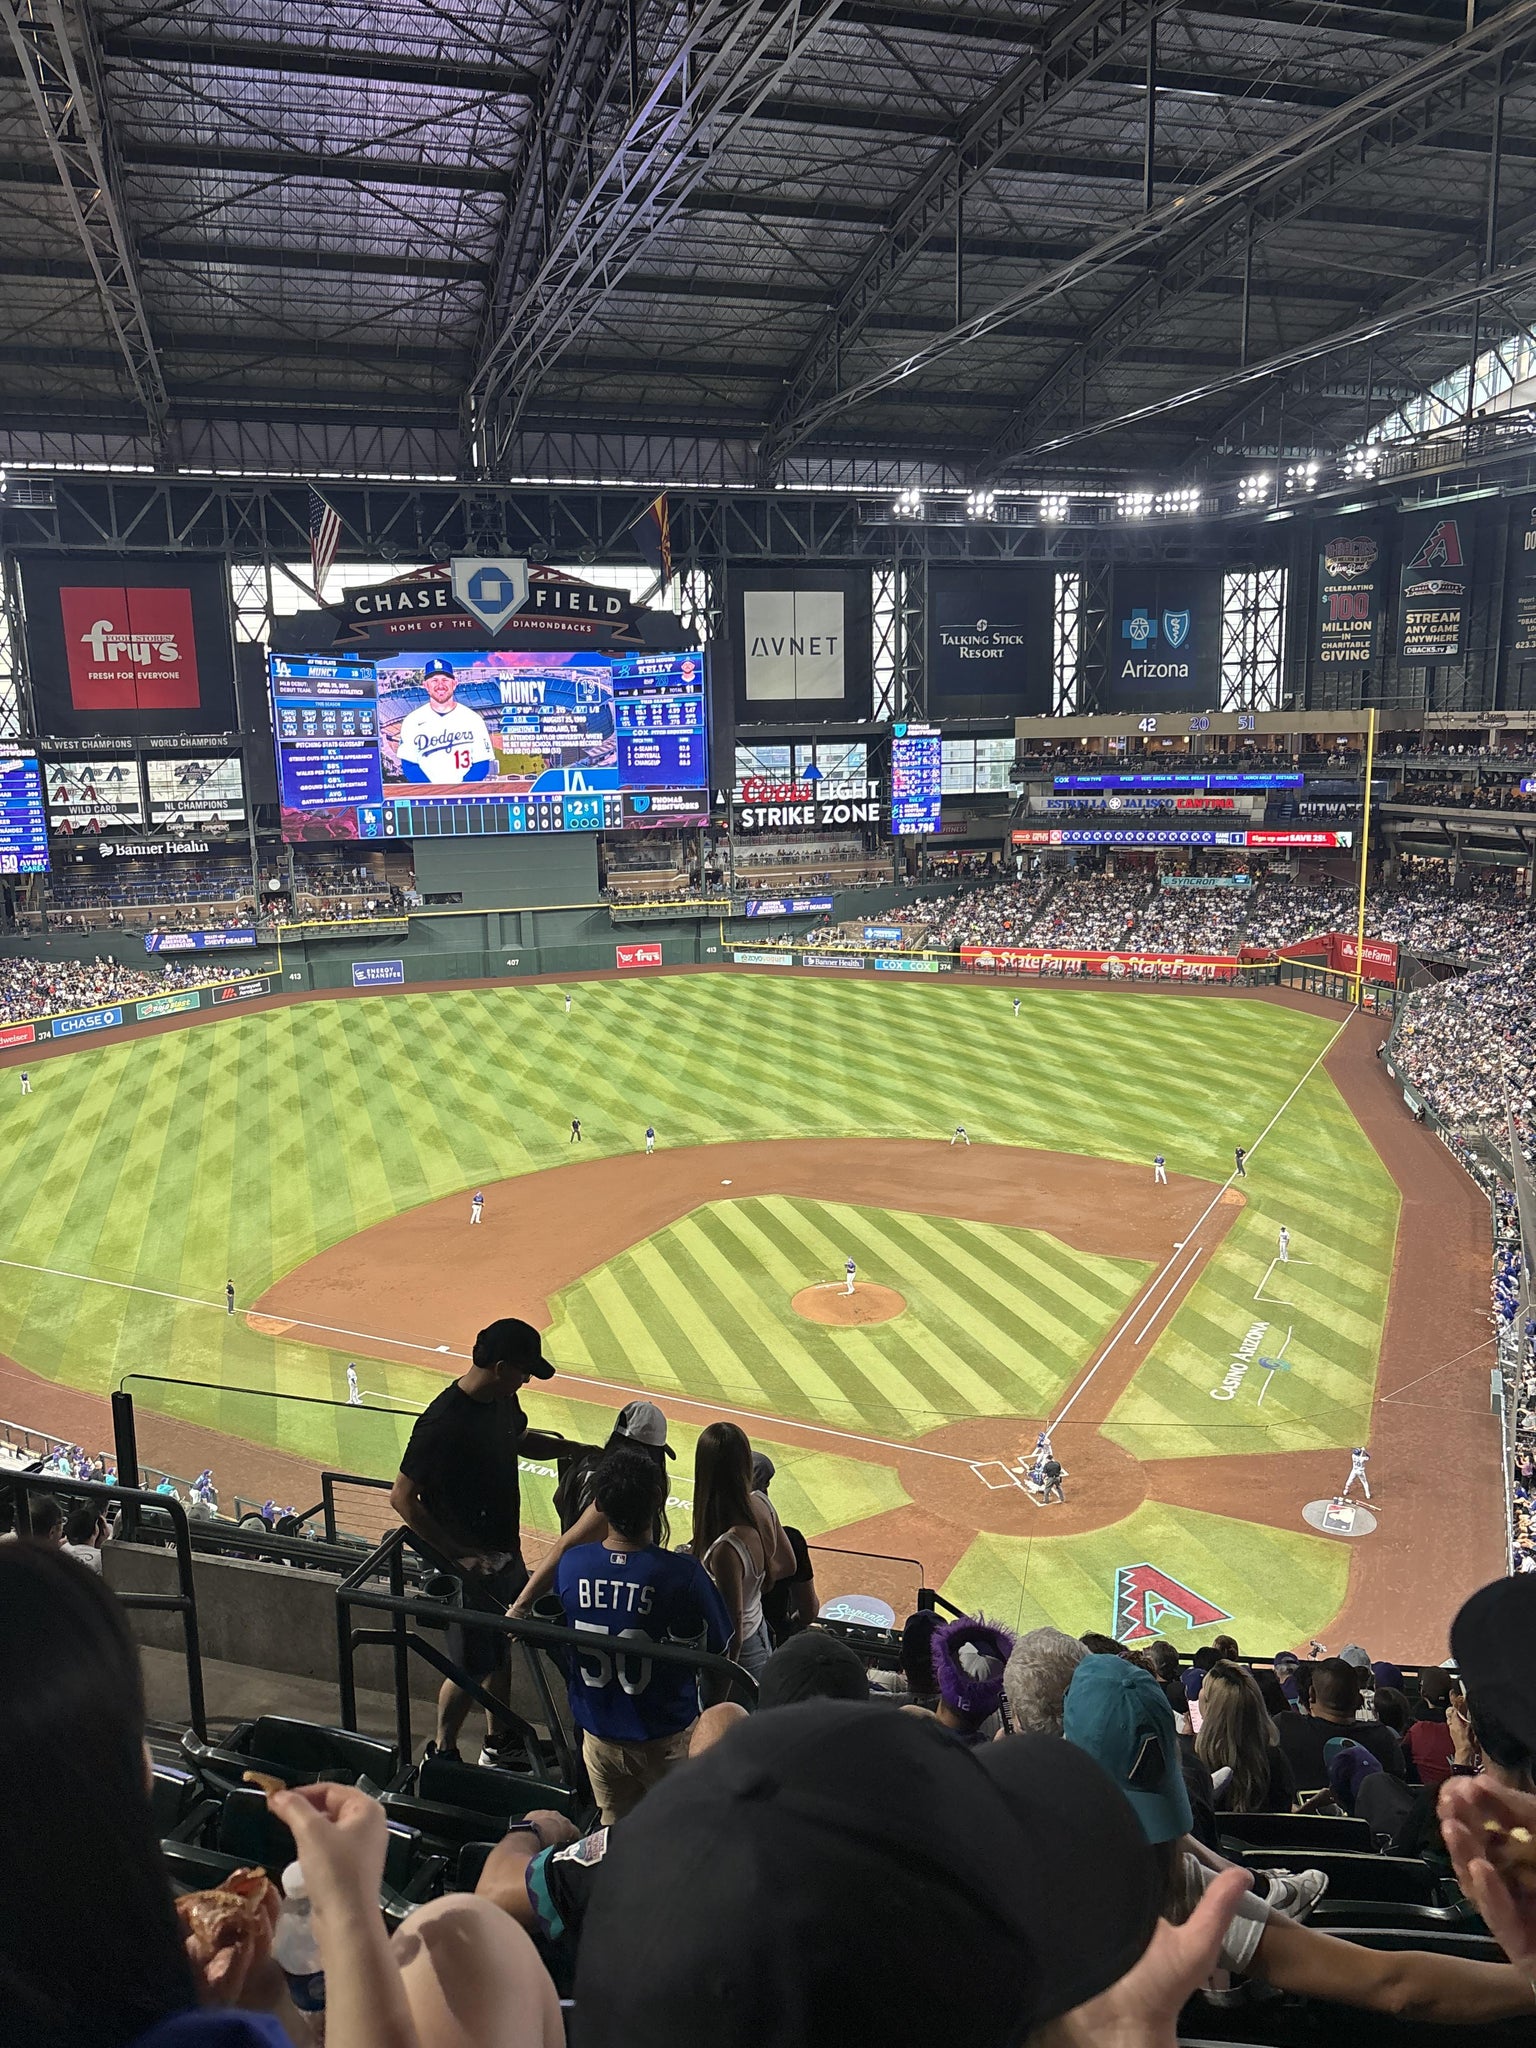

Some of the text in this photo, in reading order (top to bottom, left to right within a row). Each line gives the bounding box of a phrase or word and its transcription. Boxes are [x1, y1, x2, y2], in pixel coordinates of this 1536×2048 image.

[1329, 562, 1369, 574] Give Back
[1324, 584, 1374, 592] CELEBRATING
[355, 589, 622, 615] CHASE FIELD
[1322, 592, 1369, 620] $100
[1405, 612, 1460, 624] STREAM
[390, 620, 592, 633] HOME OF THE DIAMONDBACKS
[1322, 621, 1372, 632] MILLION
[1405, 624, 1459, 634] ANY GAME
[1341, 633, 1351, 641] IN
[1404, 634, 1459, 643] ANYWHERE
[81, 620, 179, 666] fry's
[751, 637, 838, 656] AVNET
[1321, 641, 1371, 649] CHARITABLE
[1320, 650, 1370, 662] GIVING
[308, 667, 373, 679] MUNCY 13
[638, 663, 673, 674] KELLY
[1121, 659, 1189, 678] Arizona
[88, 672, 114, 680] FRESH
[137, 671, 180, 679] EVERYONE
[499, 672, 514, 681] MAX
[499, 680, 595, 704] MUNCY 13
[1138, 715, 1256, 732] 42 20 51
[41, 741, 53, 750] NL
[54, 741, 79, 749] WEST
[81, 740, 132, 749] CHAMPIONS
[150, 737, 228, 747] WORLD CHAMPIONS
[414, 728, 474, 753] Dodgers
[454, 750, 472, 769] 13
[741, 775, 812, 804] Coors
[816, 780, 880, 801] LIGHT
[164, 801, 228, 811] NL CHAMPIONS
[573, 800, 583, 816] 2
[590, 800, 598, 814] 1
[604, 803, 611, 813] 2
[613, 803, 620, 813] 4
[651, 801, 700, 811] PRINTWORKS
[1047, 798, 1235, 809] ESTRELLA JALISCO CANTINA
[69, 805, 117, 814] WILD CARD
[741, 806, 815, 828] STRIKE
[821, 803, 880, 824] ZONE
[605, 817, 611, 826] 2
[614, 817, 620, 826] 4
[898, 823, 935, 834] $23,796
[1290, 834, 1312, 842] SAVE
[116, 842, 163, 856] Banner
[882, 961, 903, 969] COX
[366, 967, 394, 976] ENERGY
[367, 972, 402, 980] TRANSFER
[60, 1017, 103, 1033] CHASE
[38, 1031, 51, 1041] 374
[578, 1578, 656, 1615] BETTS
[574, 1620, 653, 1695] 50
